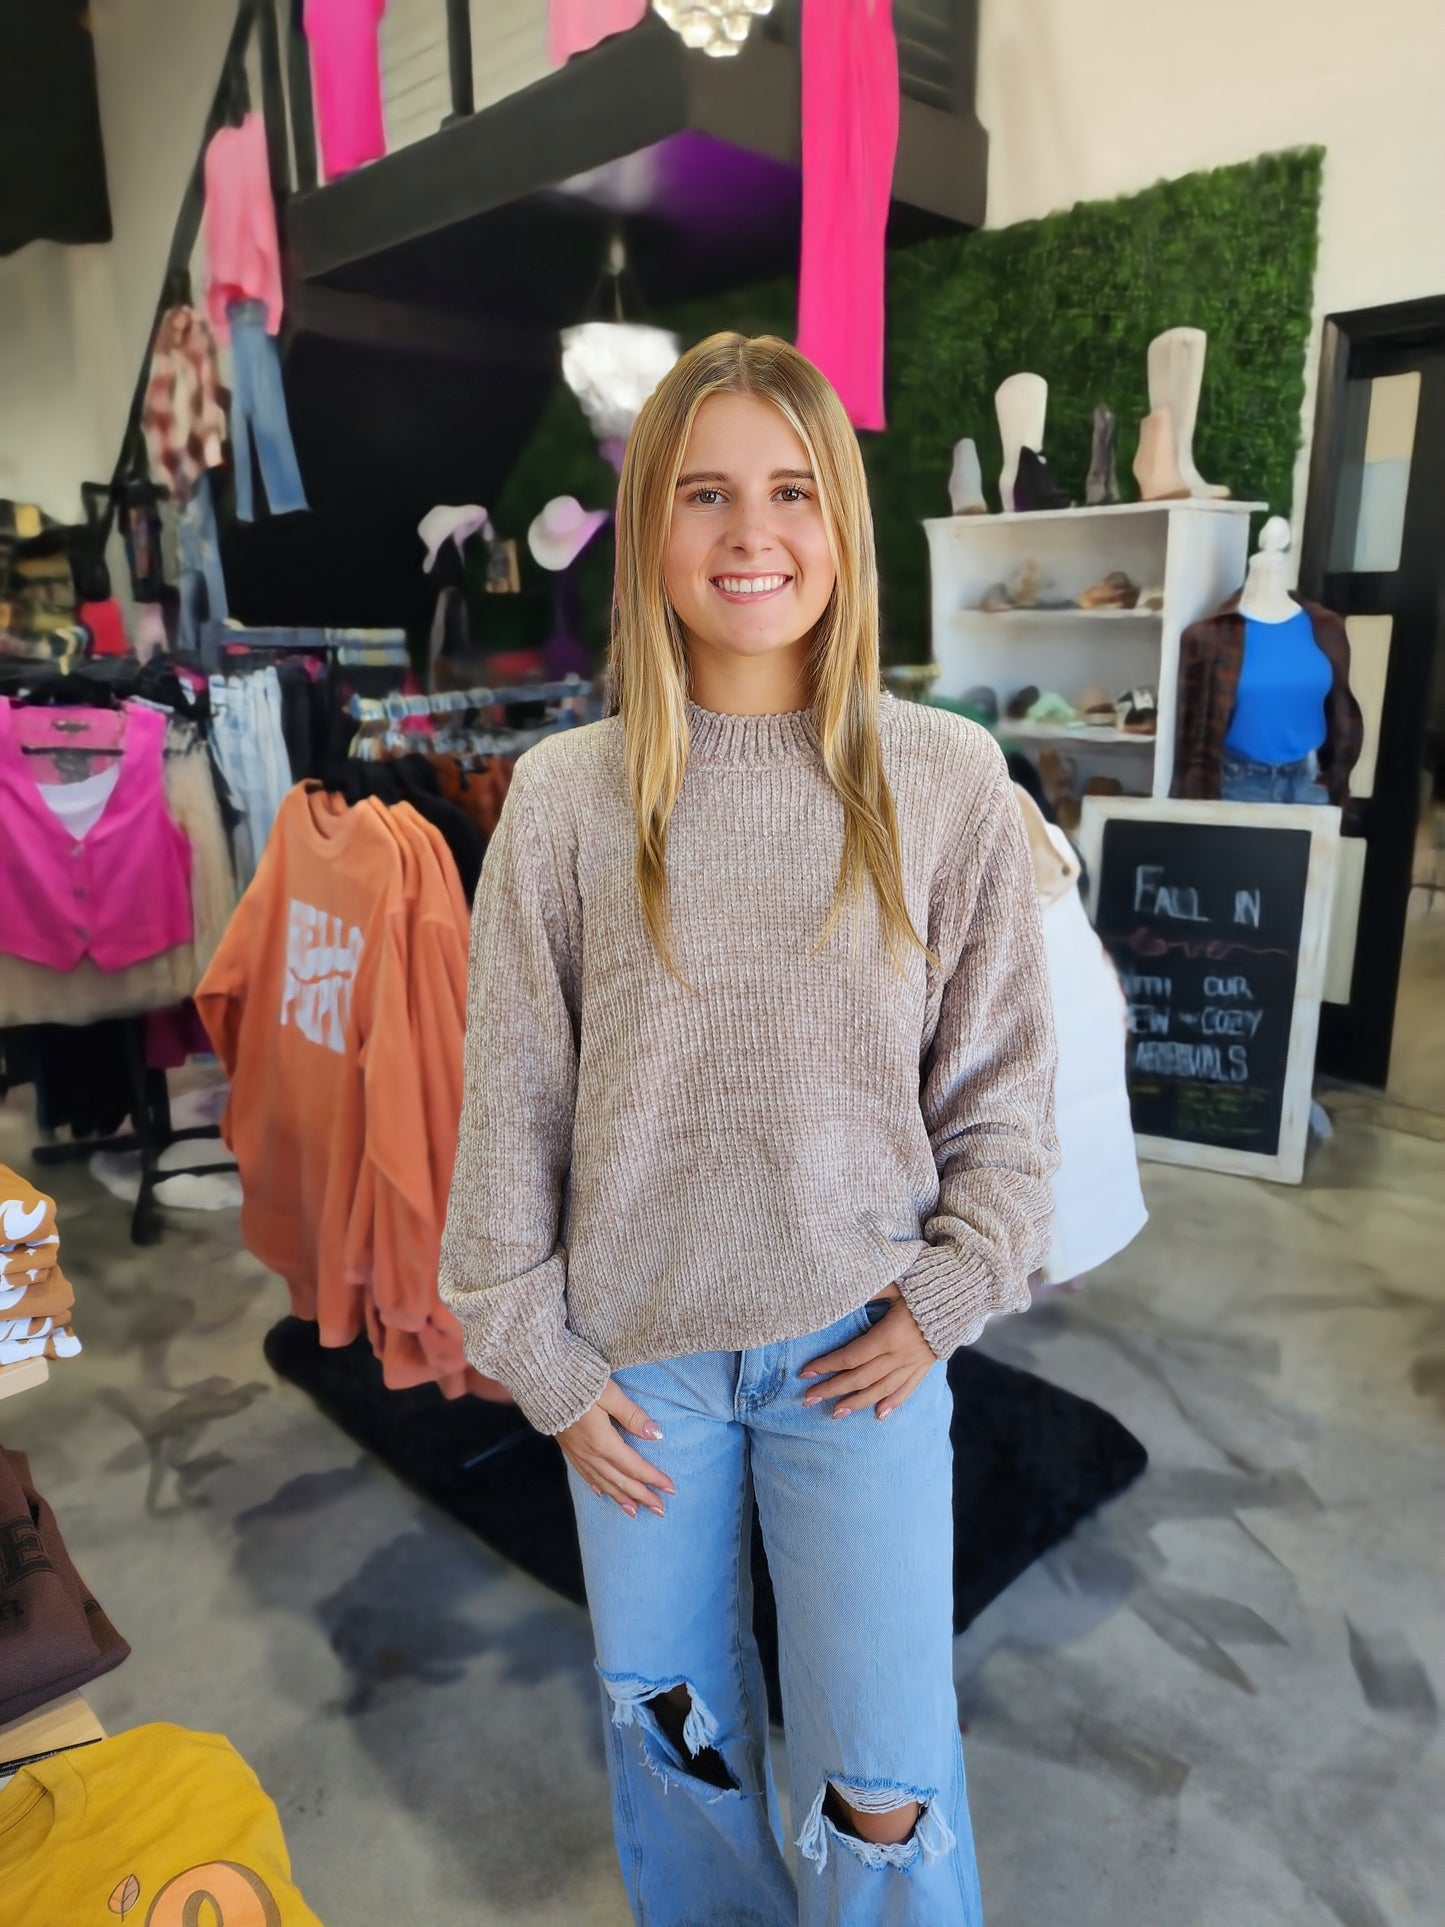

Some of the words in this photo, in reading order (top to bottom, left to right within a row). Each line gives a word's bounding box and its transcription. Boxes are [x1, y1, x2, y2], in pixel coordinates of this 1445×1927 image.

[1134, 864, 1211, 922] FALL
[1233, 888, 1261, 929] IN
[1203, 975, 1254, 999] OUR
[1201, 1005, 1264, 1037] COZY
